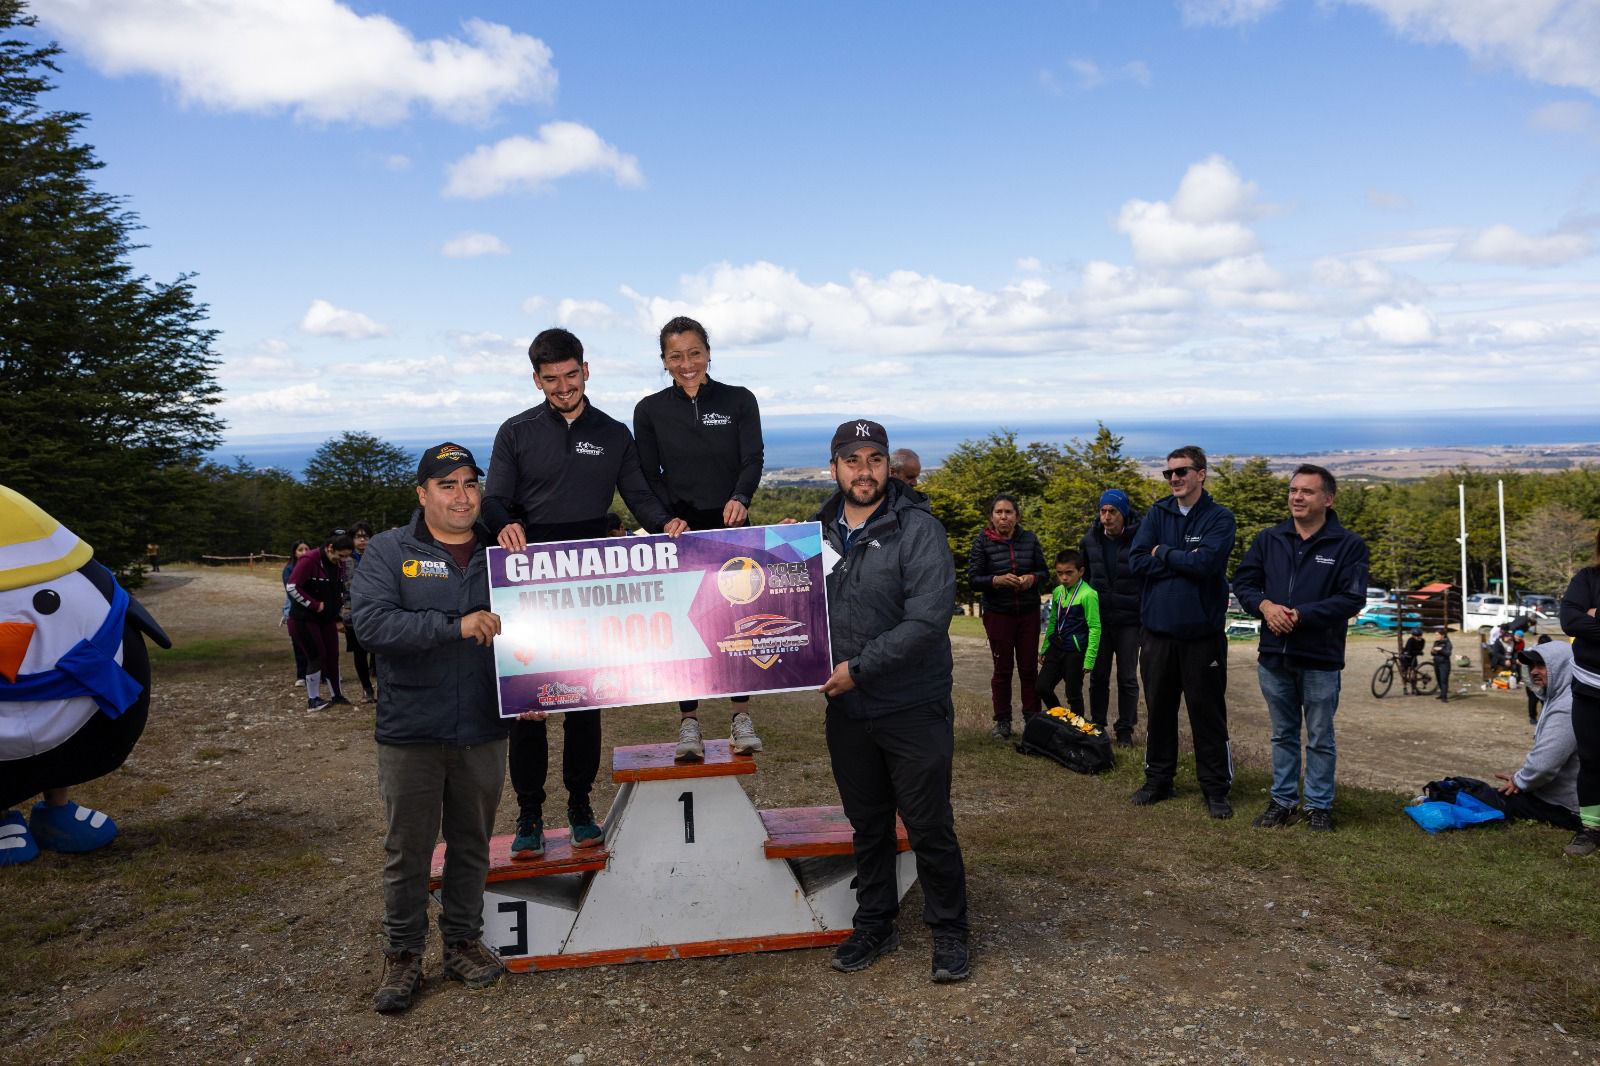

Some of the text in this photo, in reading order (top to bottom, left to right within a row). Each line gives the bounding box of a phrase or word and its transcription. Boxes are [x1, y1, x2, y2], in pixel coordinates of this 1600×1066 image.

[855, 422, 871, 437] NY
[420, 560, 447, 569] YOER
[505, 542, 679, 582] GANADOR
[767, 562, 809, 577] YOER
[518, 580, 665, 611] META VOLANTE
[769, 587, 787, 595] RENT
[796, 585, 810, 593] CAR
[677, 791, 695, 844] 1
[497, 900, 529, 957] 3
